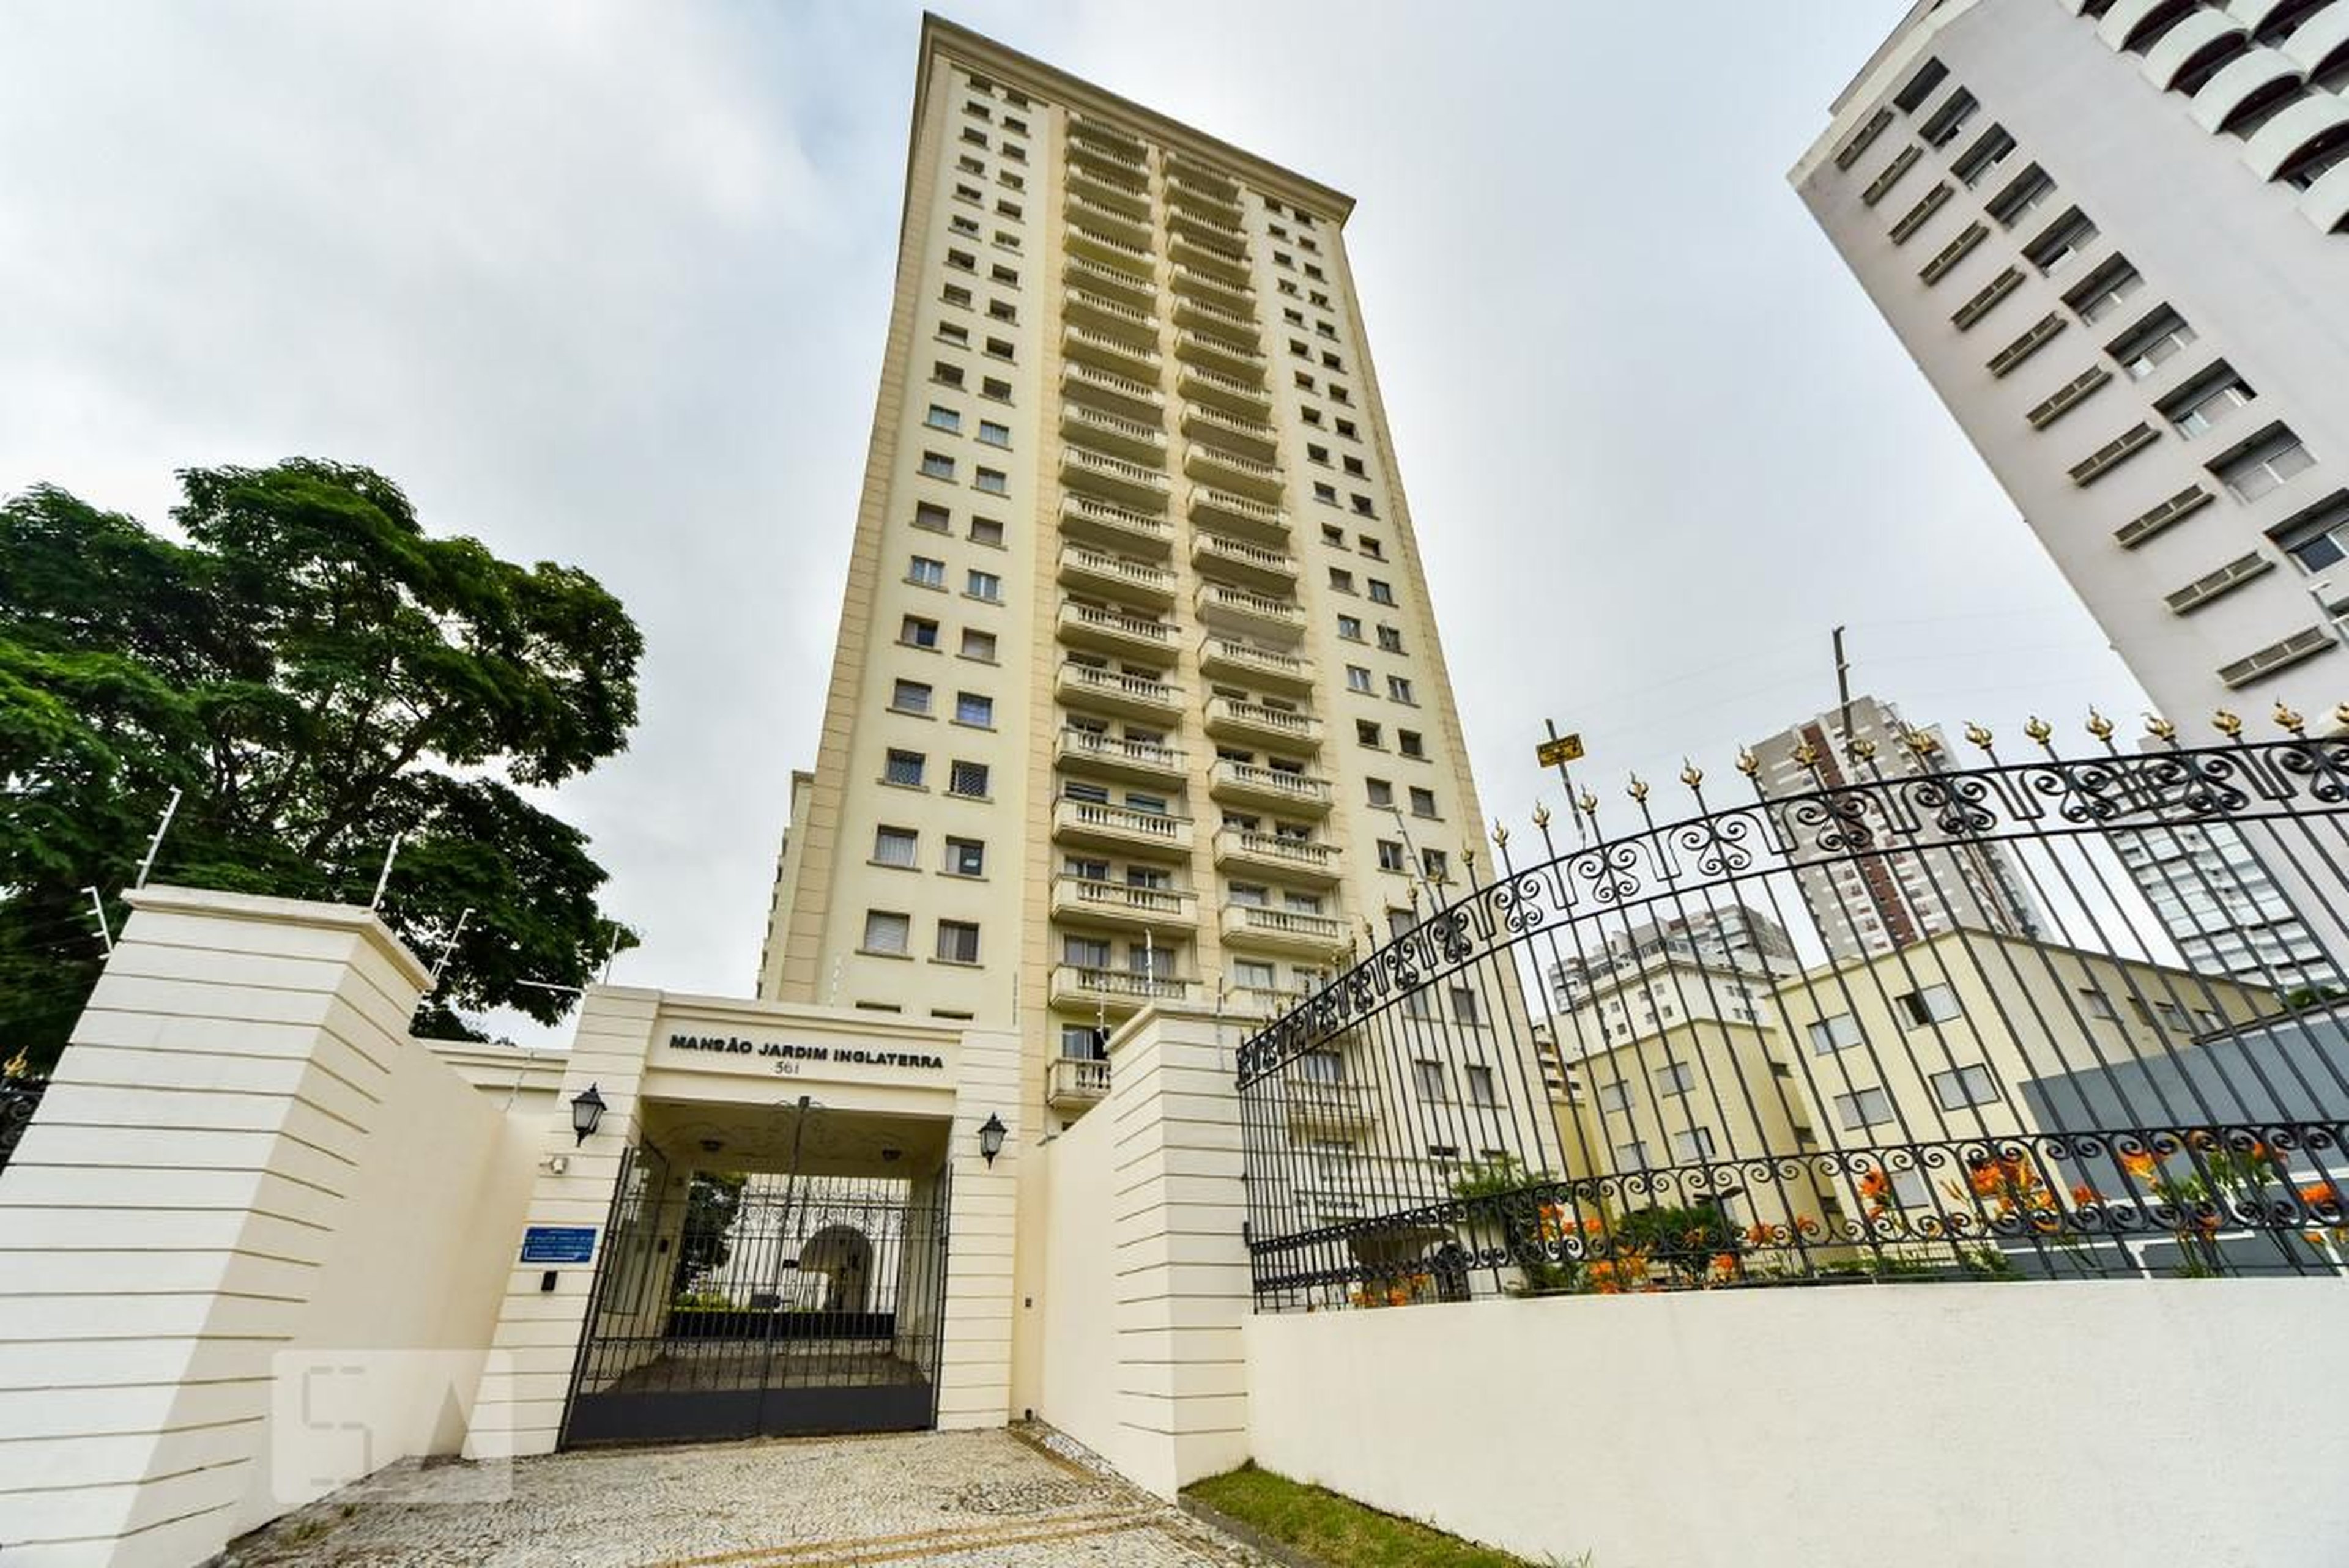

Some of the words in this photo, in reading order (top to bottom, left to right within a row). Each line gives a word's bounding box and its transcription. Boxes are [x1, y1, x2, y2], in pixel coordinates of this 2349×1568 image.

[670, 1035, 752, 1054] MANSÃO
[758, 1043, 827, 1060] JARDIM
[833, 1049, 943, 1068] INGLATERRA
[774, 1061, 800, 1074] 561
